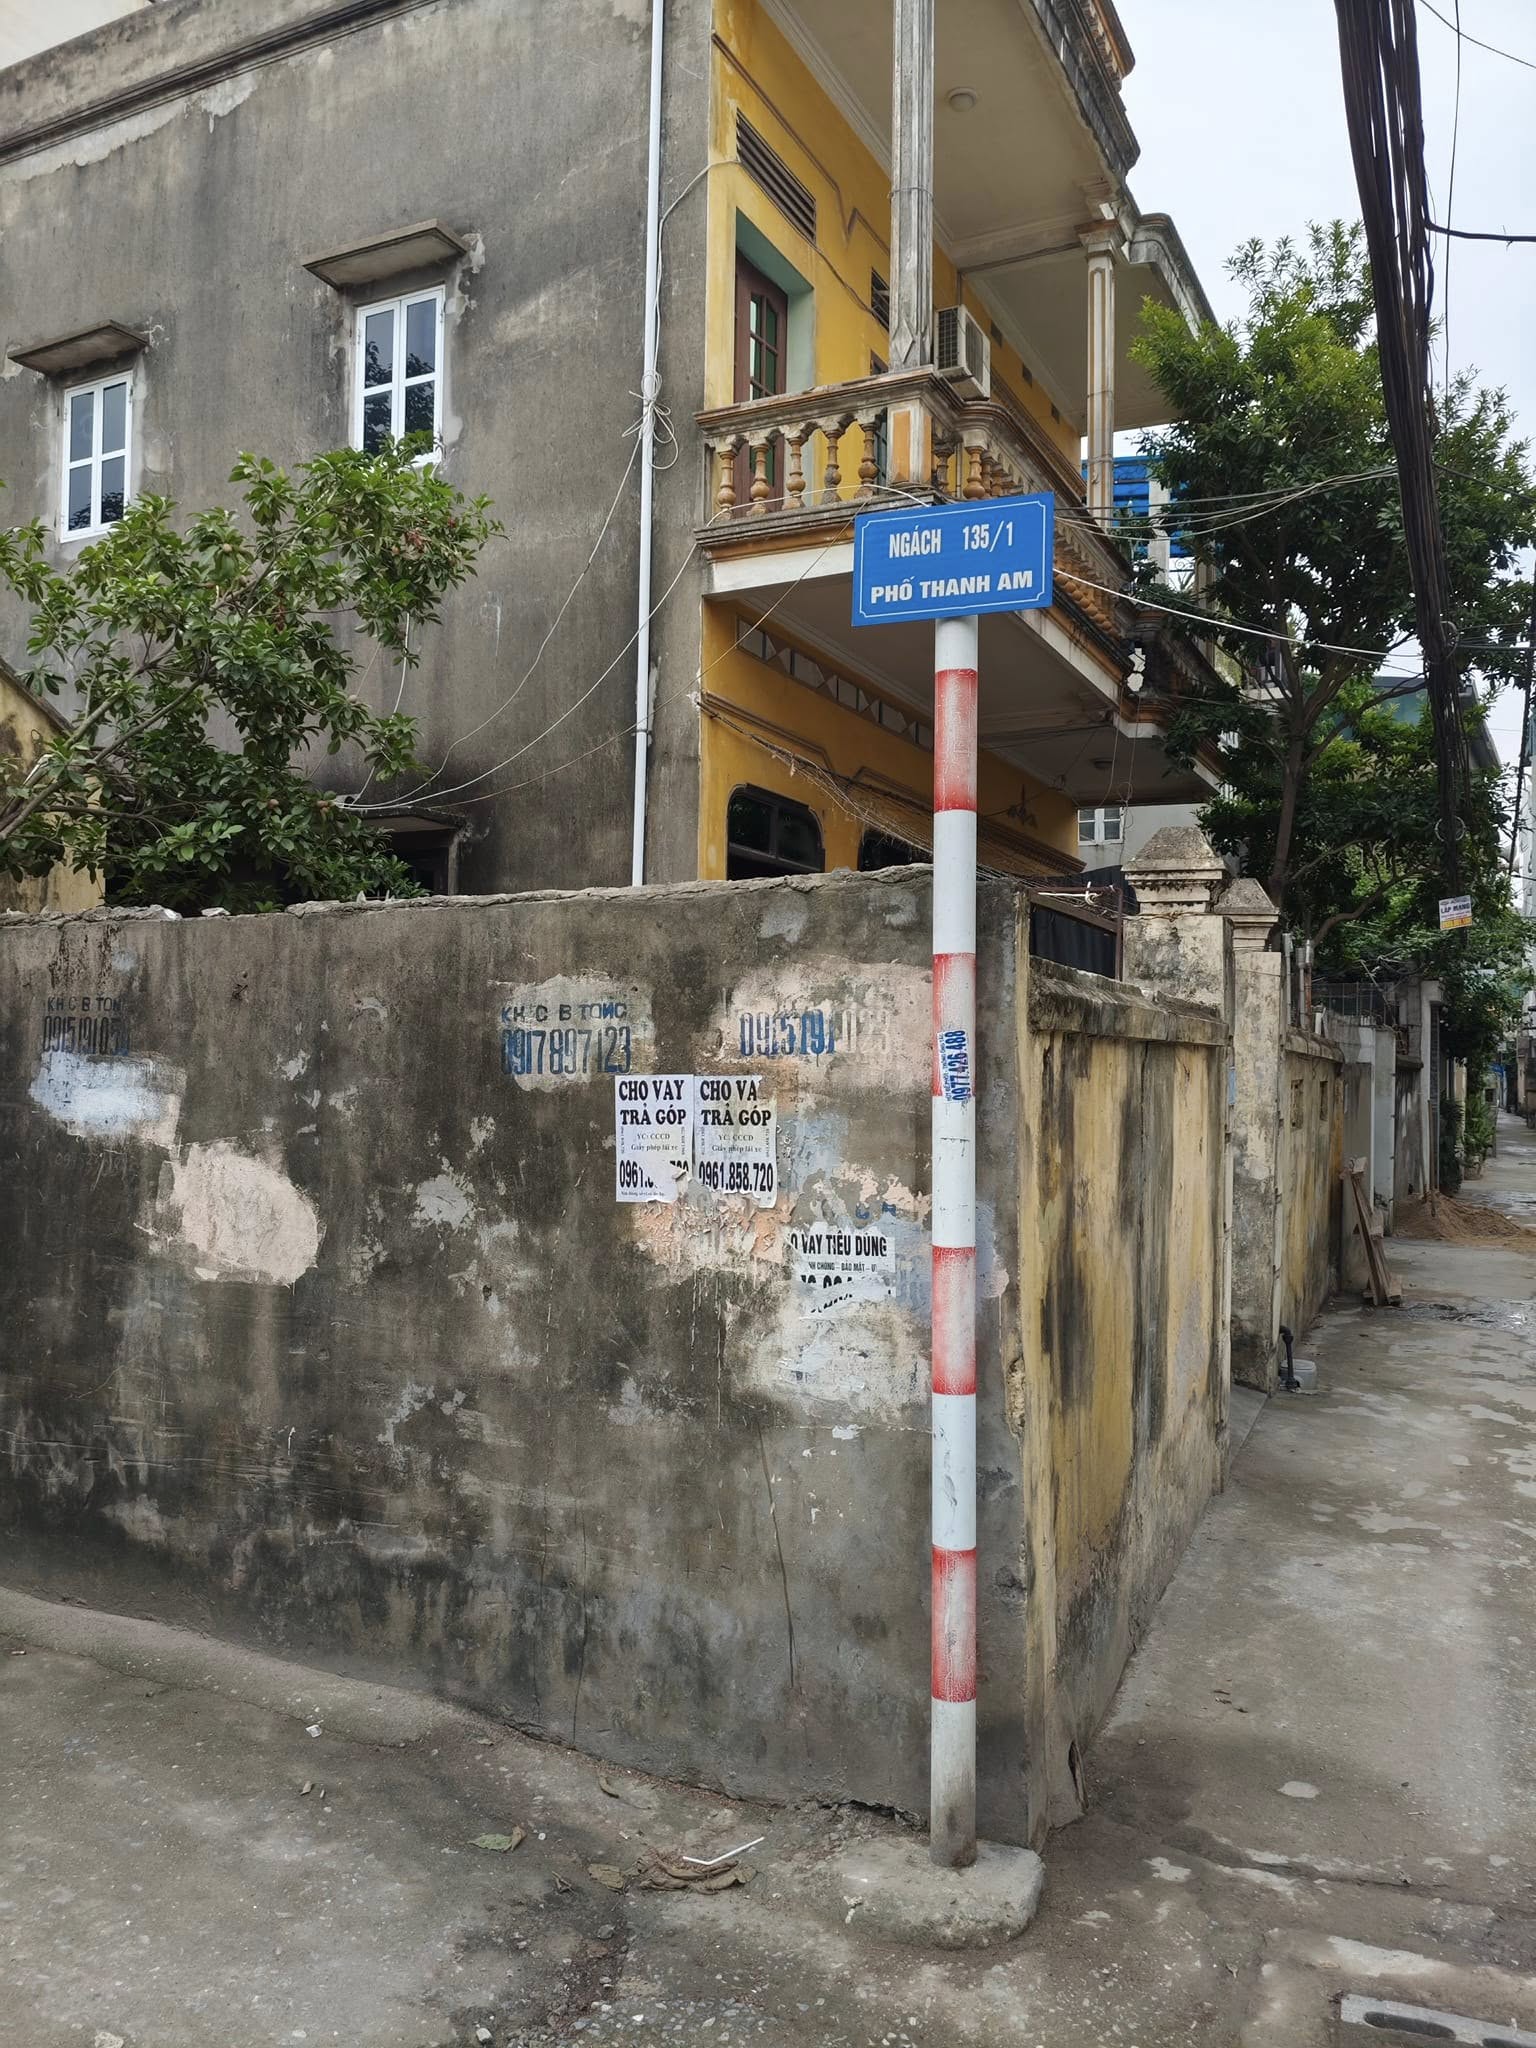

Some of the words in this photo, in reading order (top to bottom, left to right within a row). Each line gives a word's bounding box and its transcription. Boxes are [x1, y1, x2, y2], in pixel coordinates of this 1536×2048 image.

[889, 525, 941, 558] NGÁCH
[962, 521, 1013, 552] 135/1
[871, 576, 915, 604] PHỐ
[919, 575, 990, 599] THANH
[997, 570, 1033, 591] AM
[944, 1030, 971, 1100] 0977.426.488
[619, 1080, 648, 1101] CHO
[652, 1080, 684, 1101] VAY
[700, 1080, 731, 1101] CHO
[736, 1080, 760, 1101] VA
[620, 1102, 651, 1125] TRẢ
[655, 1104, 686, 1125] GÓP
[701, 1102, 734, 1126] TRẢ
[739, 1105, 771, 1126] GÓP
[699, 1160, 773, 1192] 0961.858.720
[801, 1234, 822, 1254] VAY
[826, 1229, 851, 1255] TIÊU
